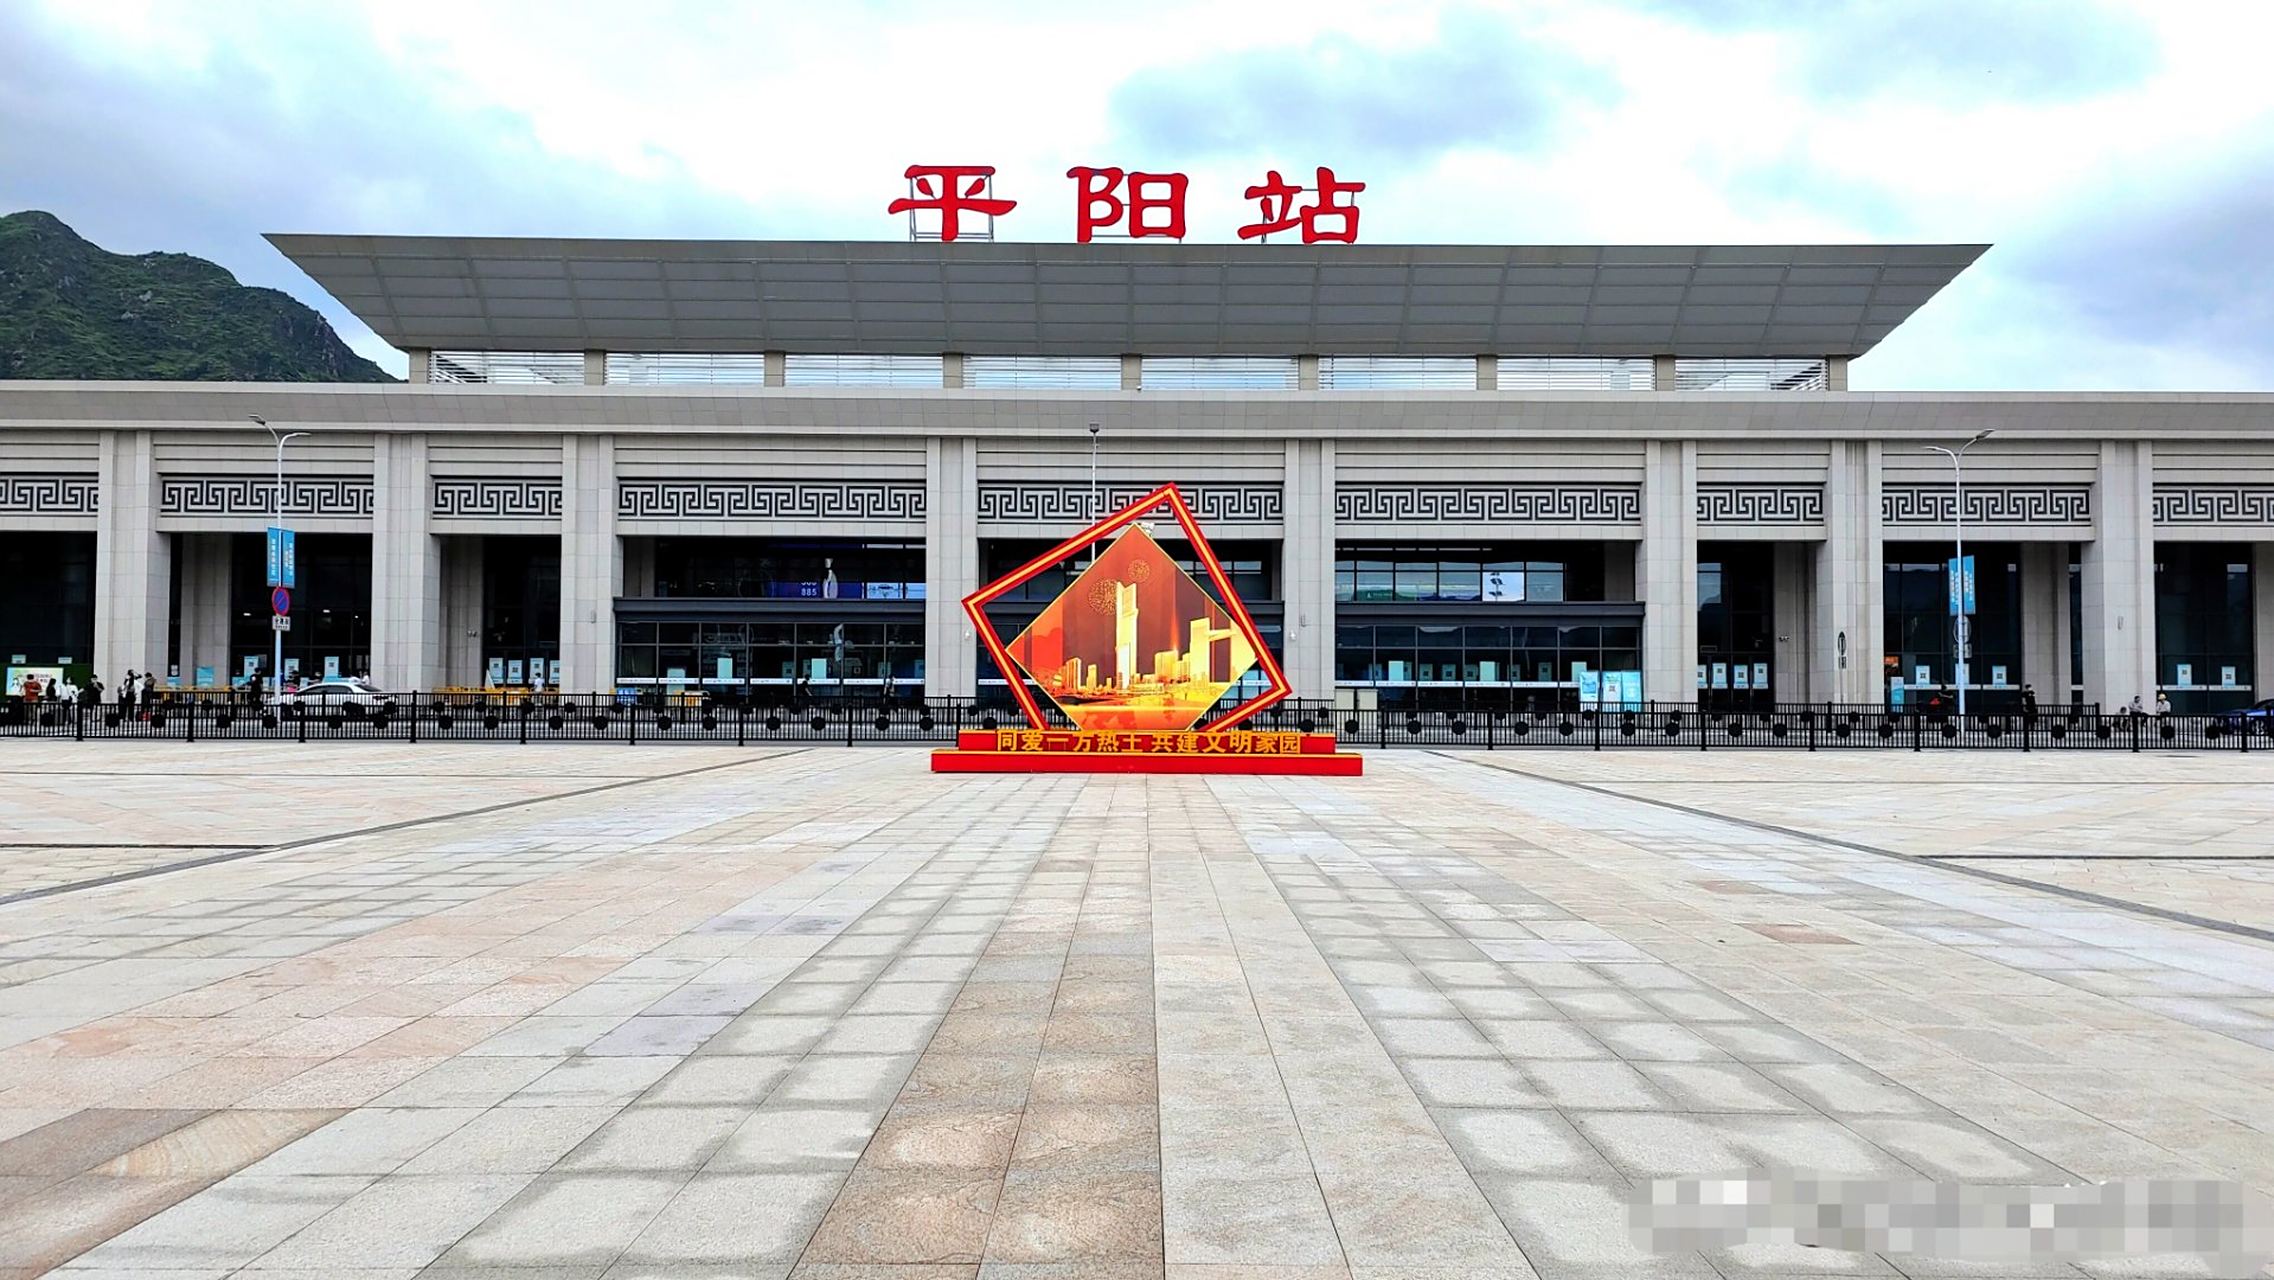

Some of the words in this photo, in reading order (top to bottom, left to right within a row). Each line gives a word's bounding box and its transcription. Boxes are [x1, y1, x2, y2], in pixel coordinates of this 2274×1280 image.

[888, 165, 1366, 244] 平阳站
[996, 730, 1143, 752] 同爱一方热土
[1151, 730, 1301, 754] 共建文明家园
